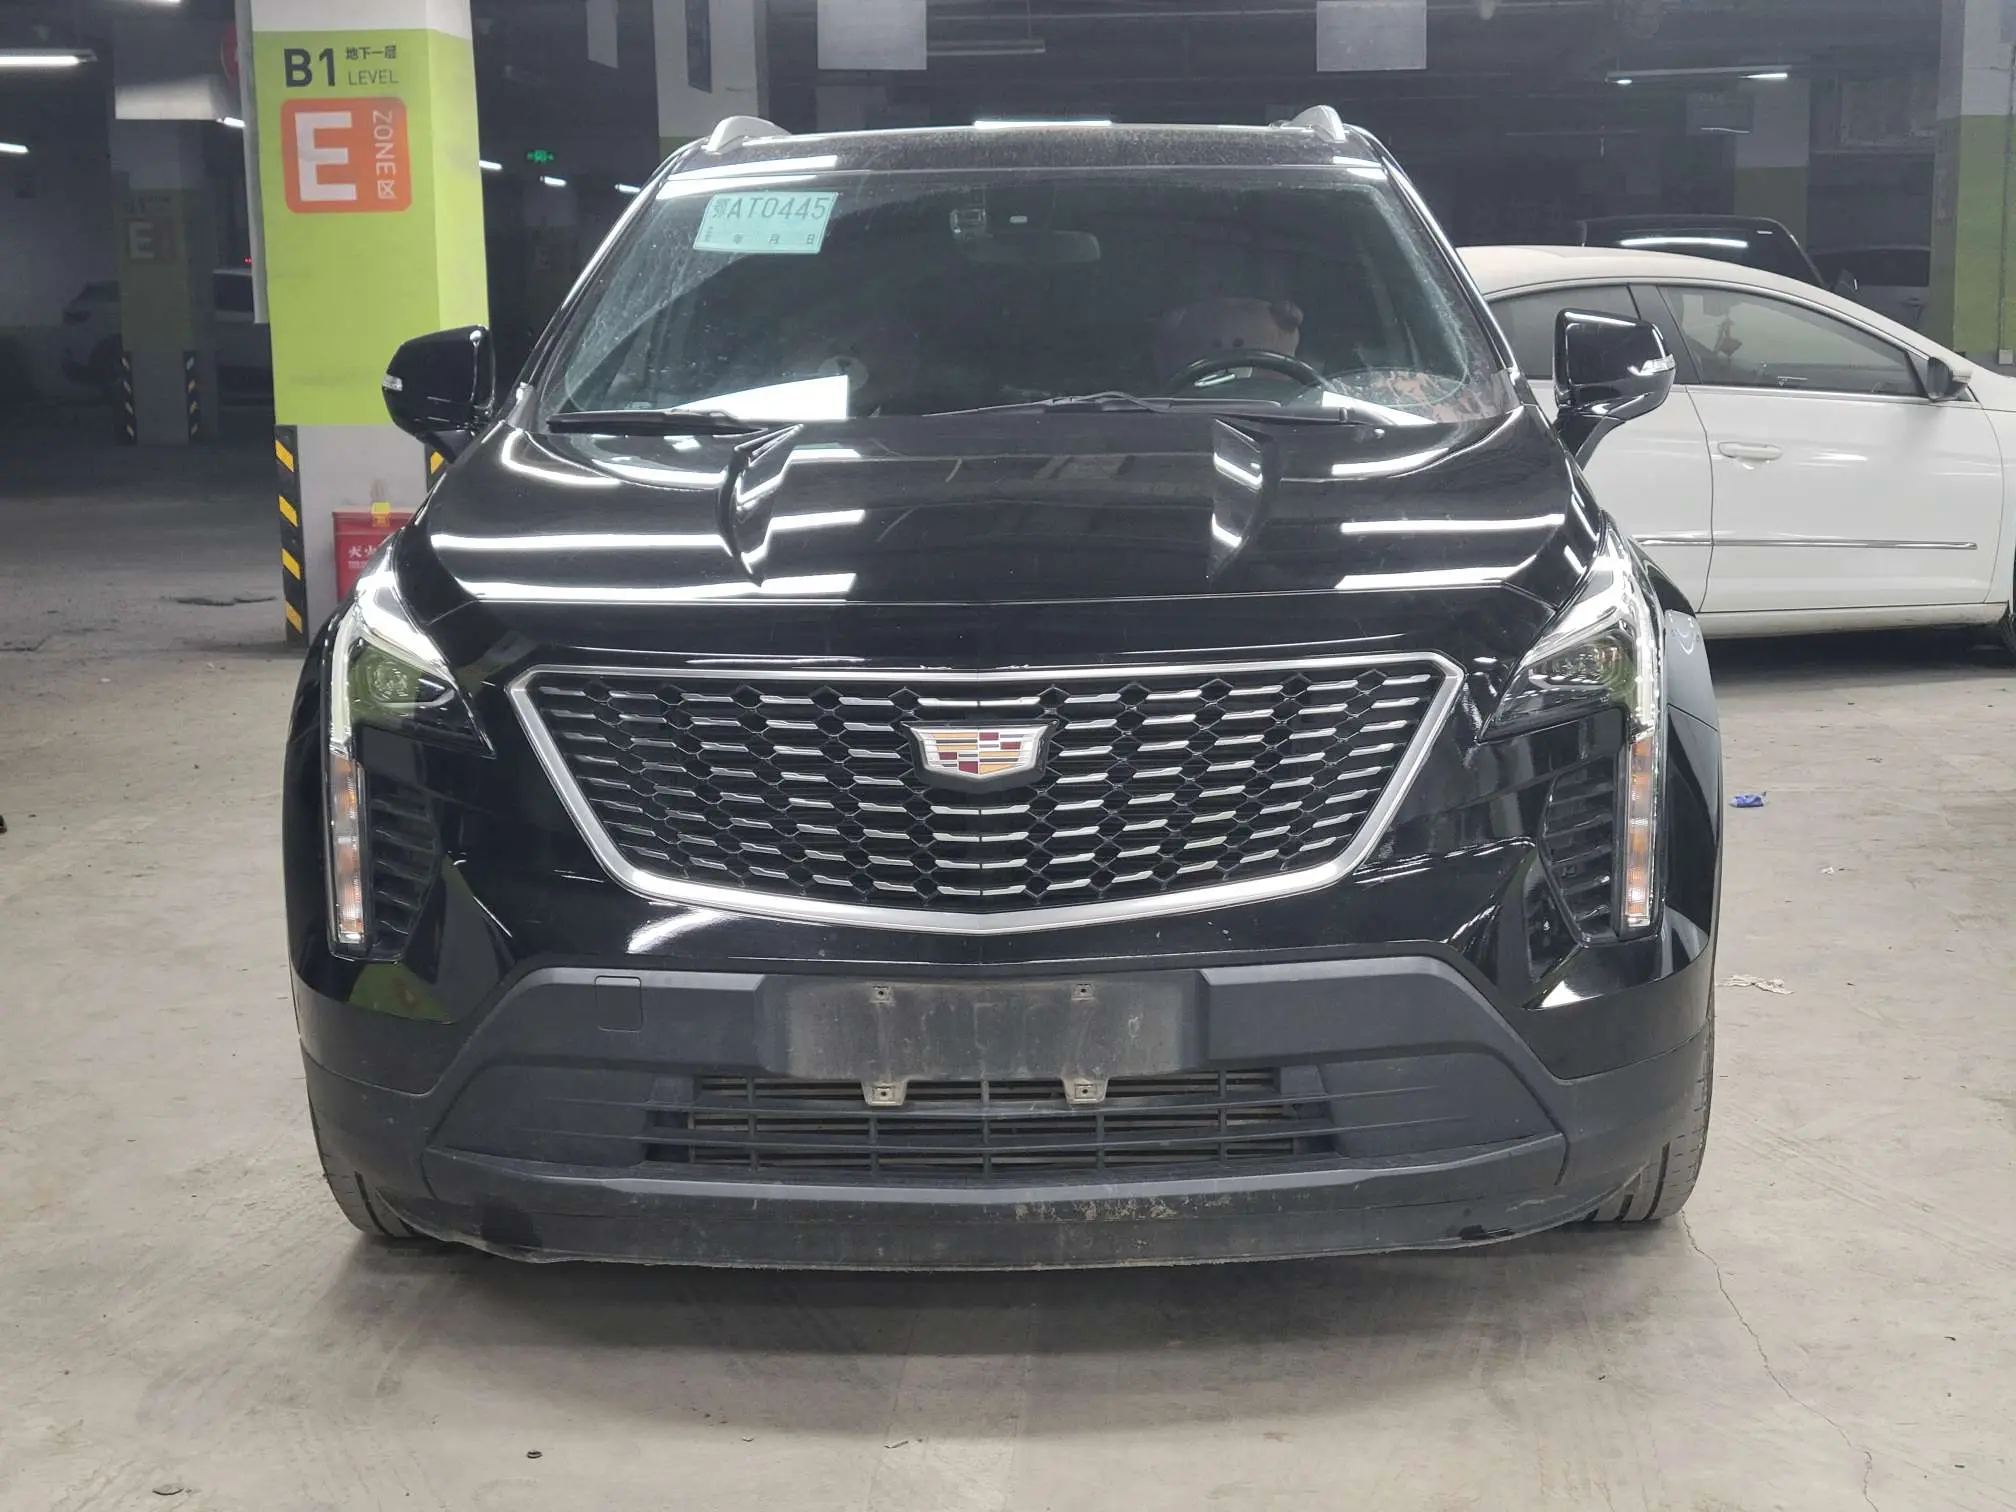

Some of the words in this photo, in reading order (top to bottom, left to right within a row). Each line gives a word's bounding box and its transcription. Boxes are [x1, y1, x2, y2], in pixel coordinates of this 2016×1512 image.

[283, 48, 336, 87] B1
[347, 69, 399, 86] LEVEL
[295, 111, 357, 202] E
